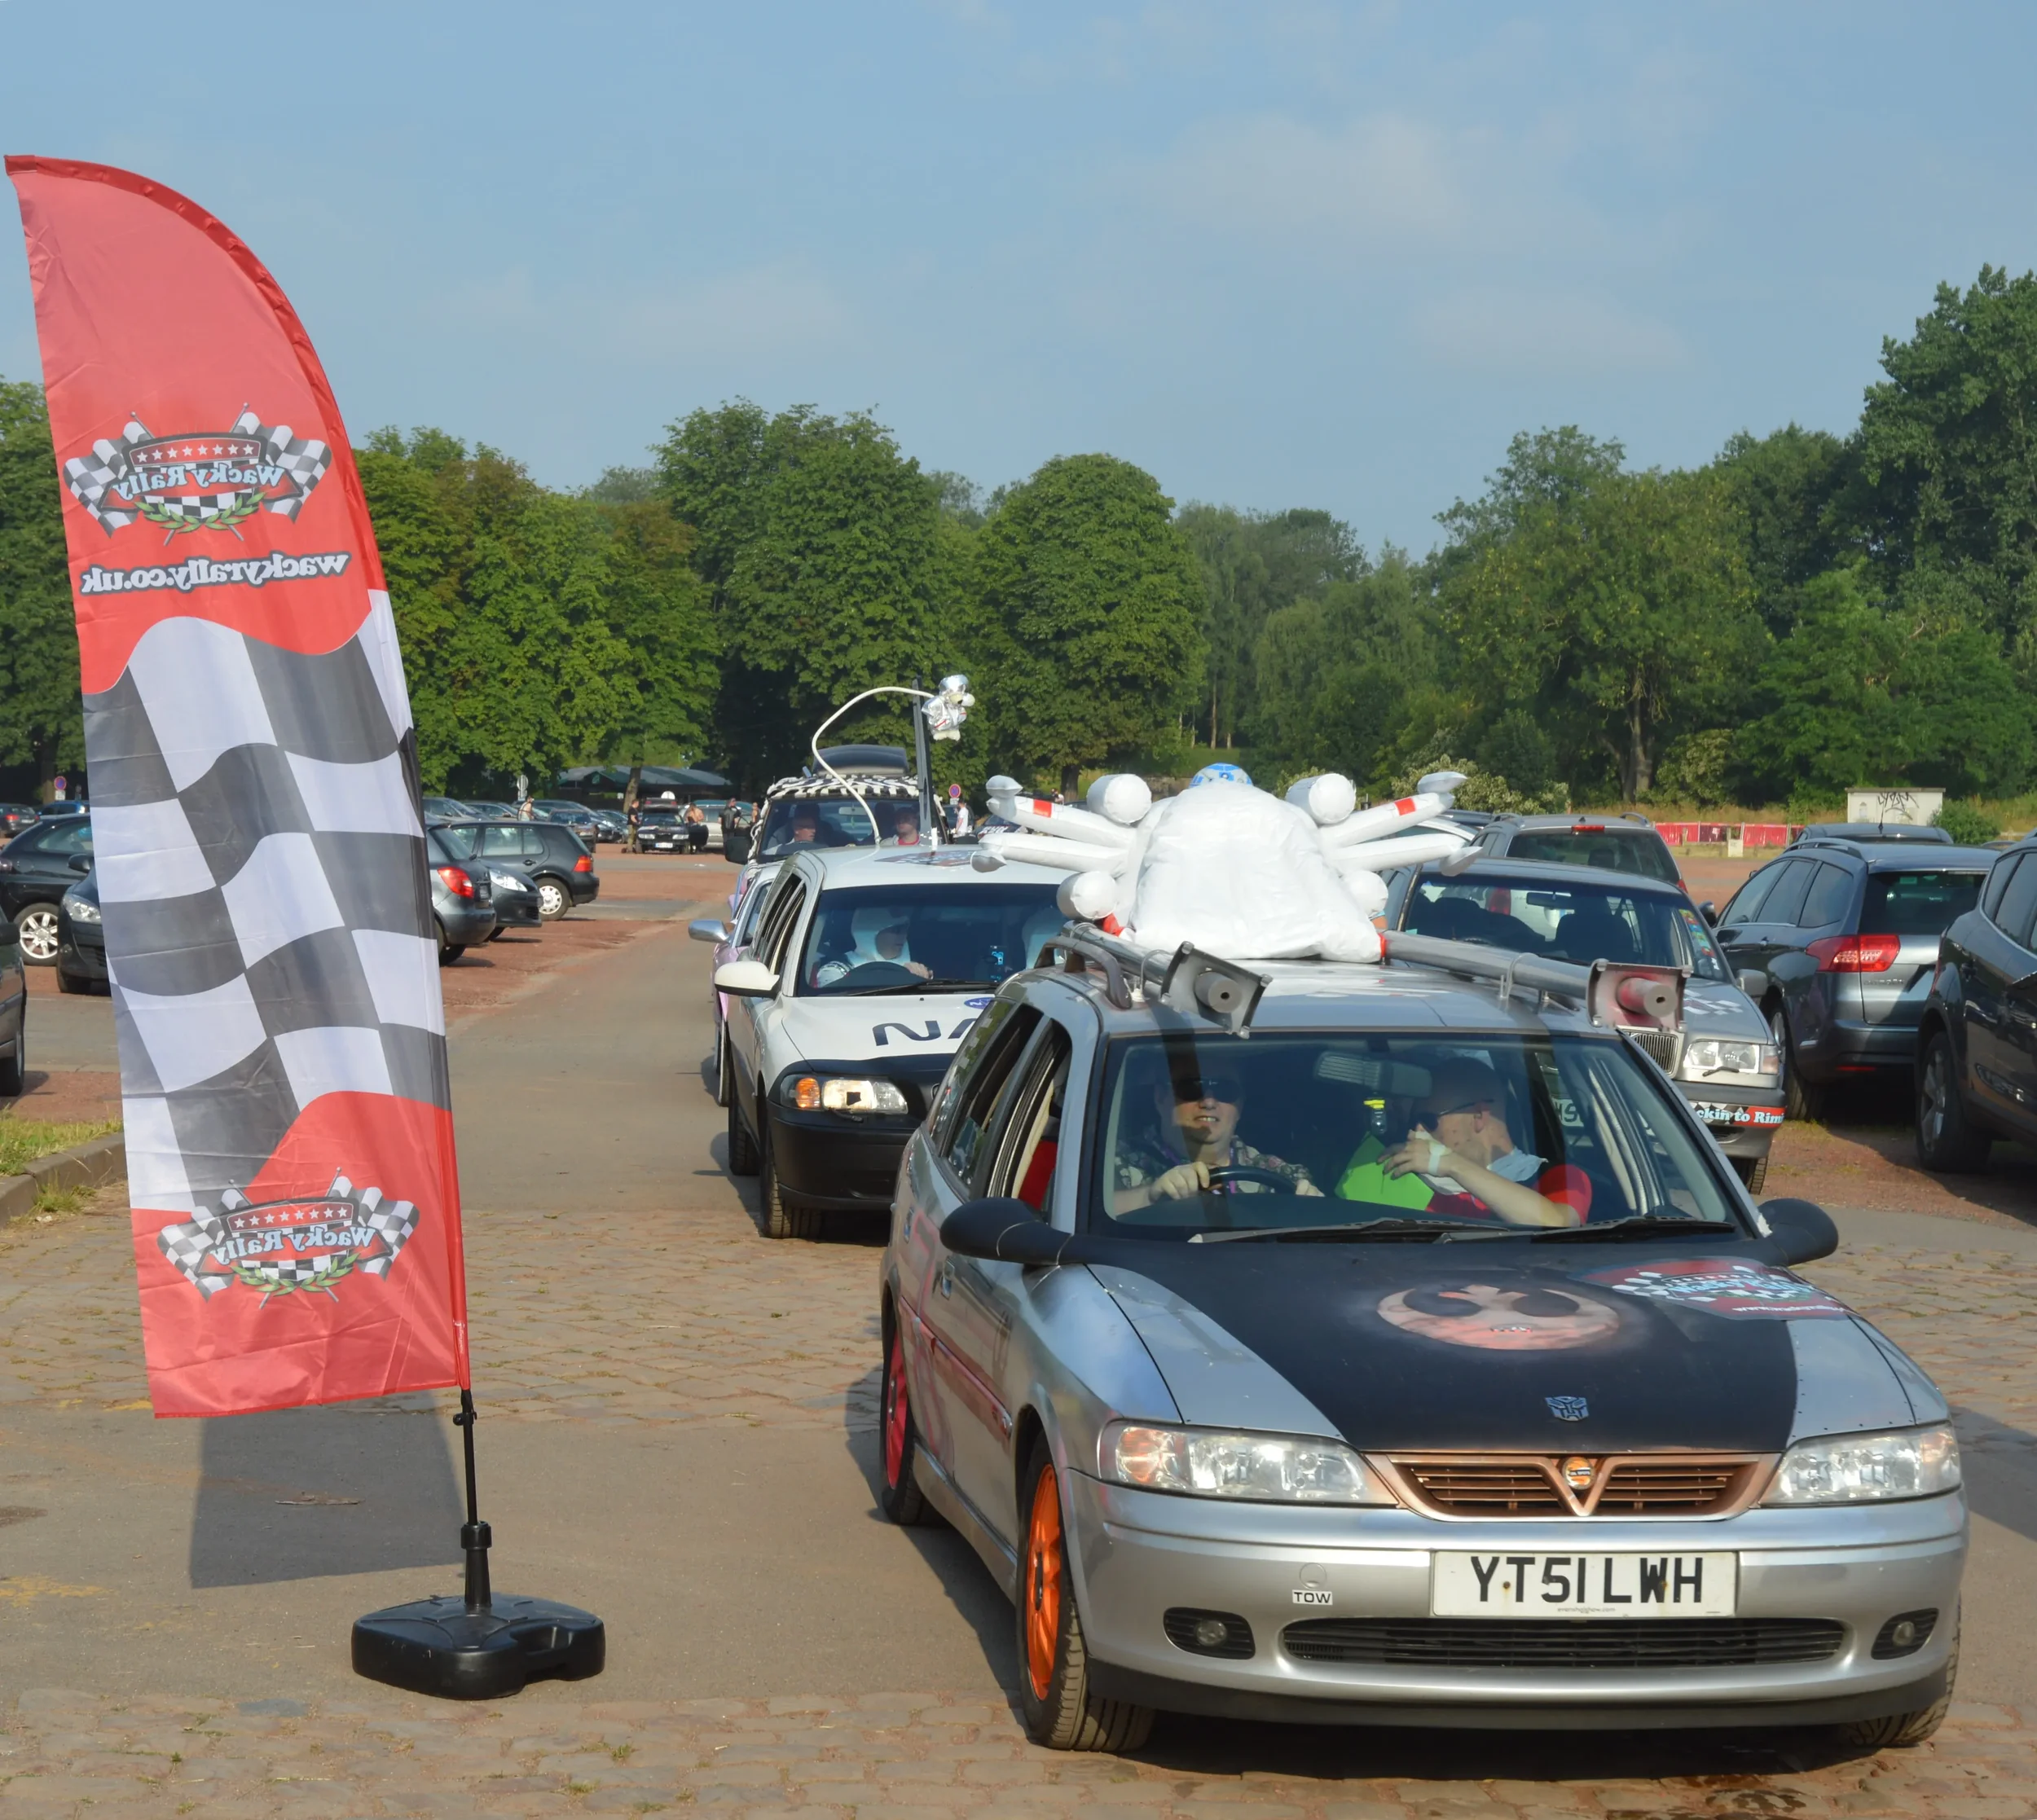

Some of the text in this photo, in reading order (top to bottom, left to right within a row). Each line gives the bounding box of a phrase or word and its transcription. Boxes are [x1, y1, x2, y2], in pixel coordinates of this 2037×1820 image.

[1734, 1111, 1751, 1122] to
[1470, 1556, 1703, 1603] YT51 LWH
[1293, 1591, 1331, 1604] TOW
